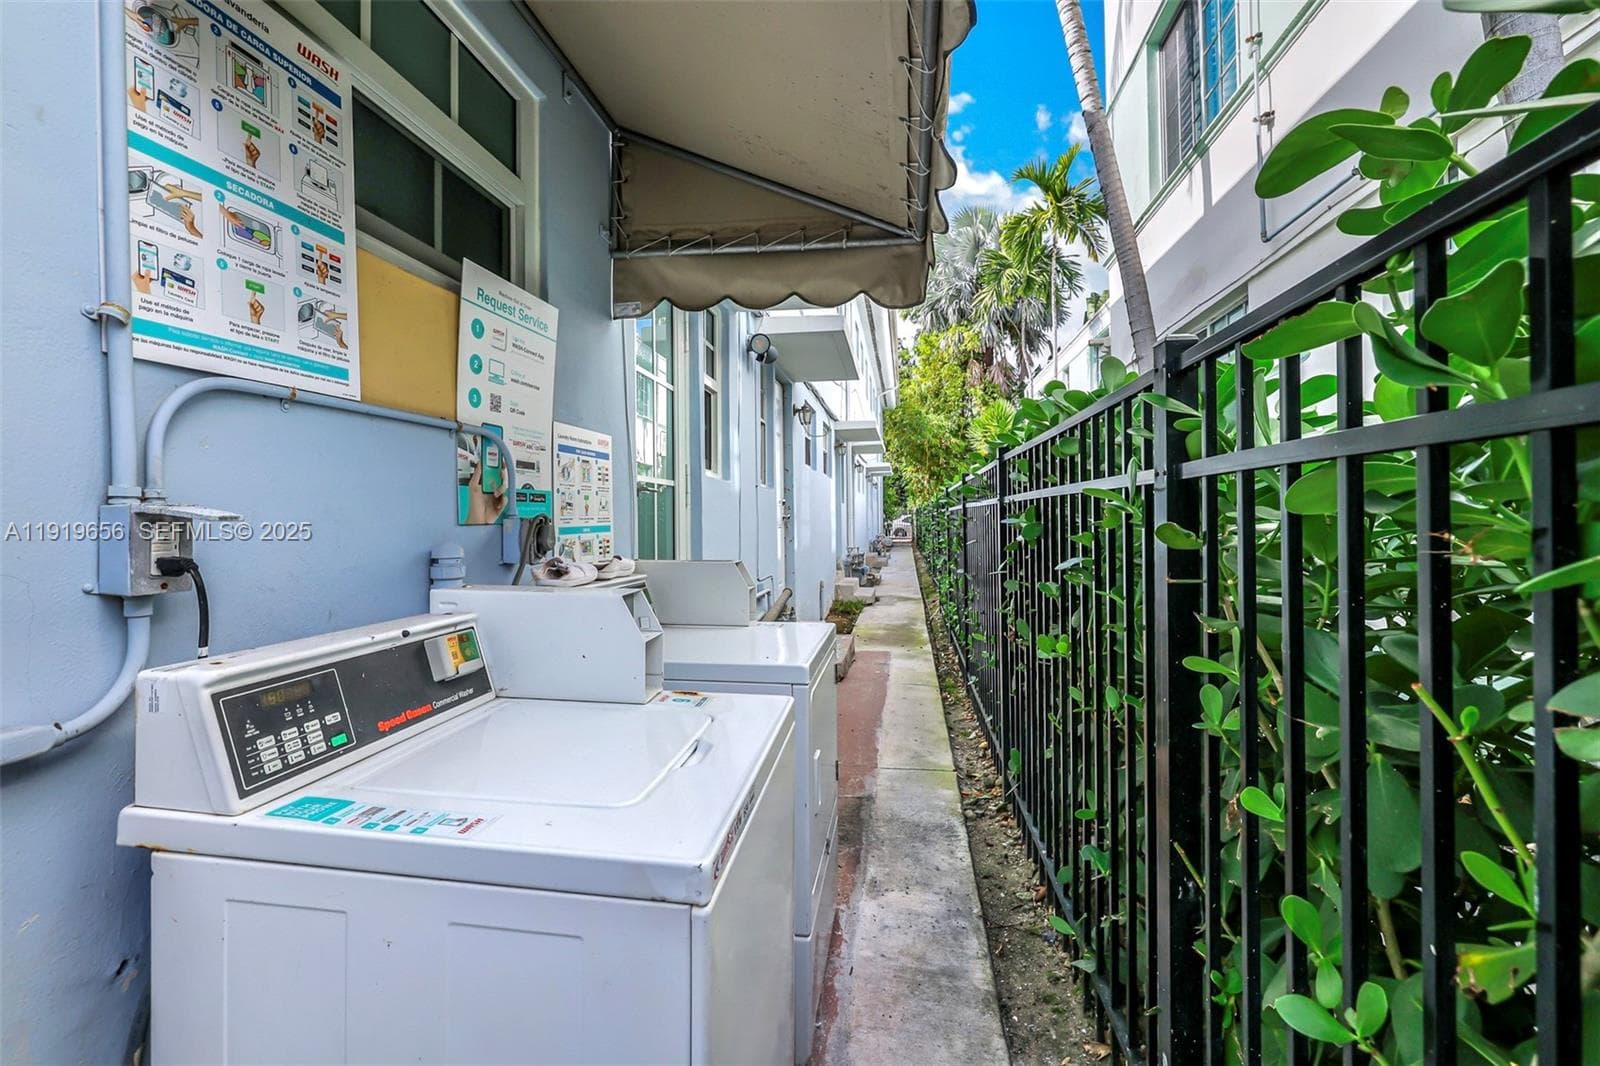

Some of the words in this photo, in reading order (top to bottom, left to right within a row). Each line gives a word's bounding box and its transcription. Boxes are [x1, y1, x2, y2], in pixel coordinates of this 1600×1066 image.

[226, 19, 240, 34] DE
[240, 30, 272, 57] CARGA
[273, 52, 313, 86] SUPERIOR
[297, 42, 339, 82] WASH
[226, 181, 275, 209] SECADORA
[138, 305, 154, 313] pago
[140, 297, 153, 305] Use
[476, 287, 517, 318] Request
[518, 308, 549, 333] Service
[377, 711, 407, 732] Speed
[406, 703, 433, 720] Queen
[432, 693, 459, 709] Commercial
[459, 688, 474, 699] Washer
